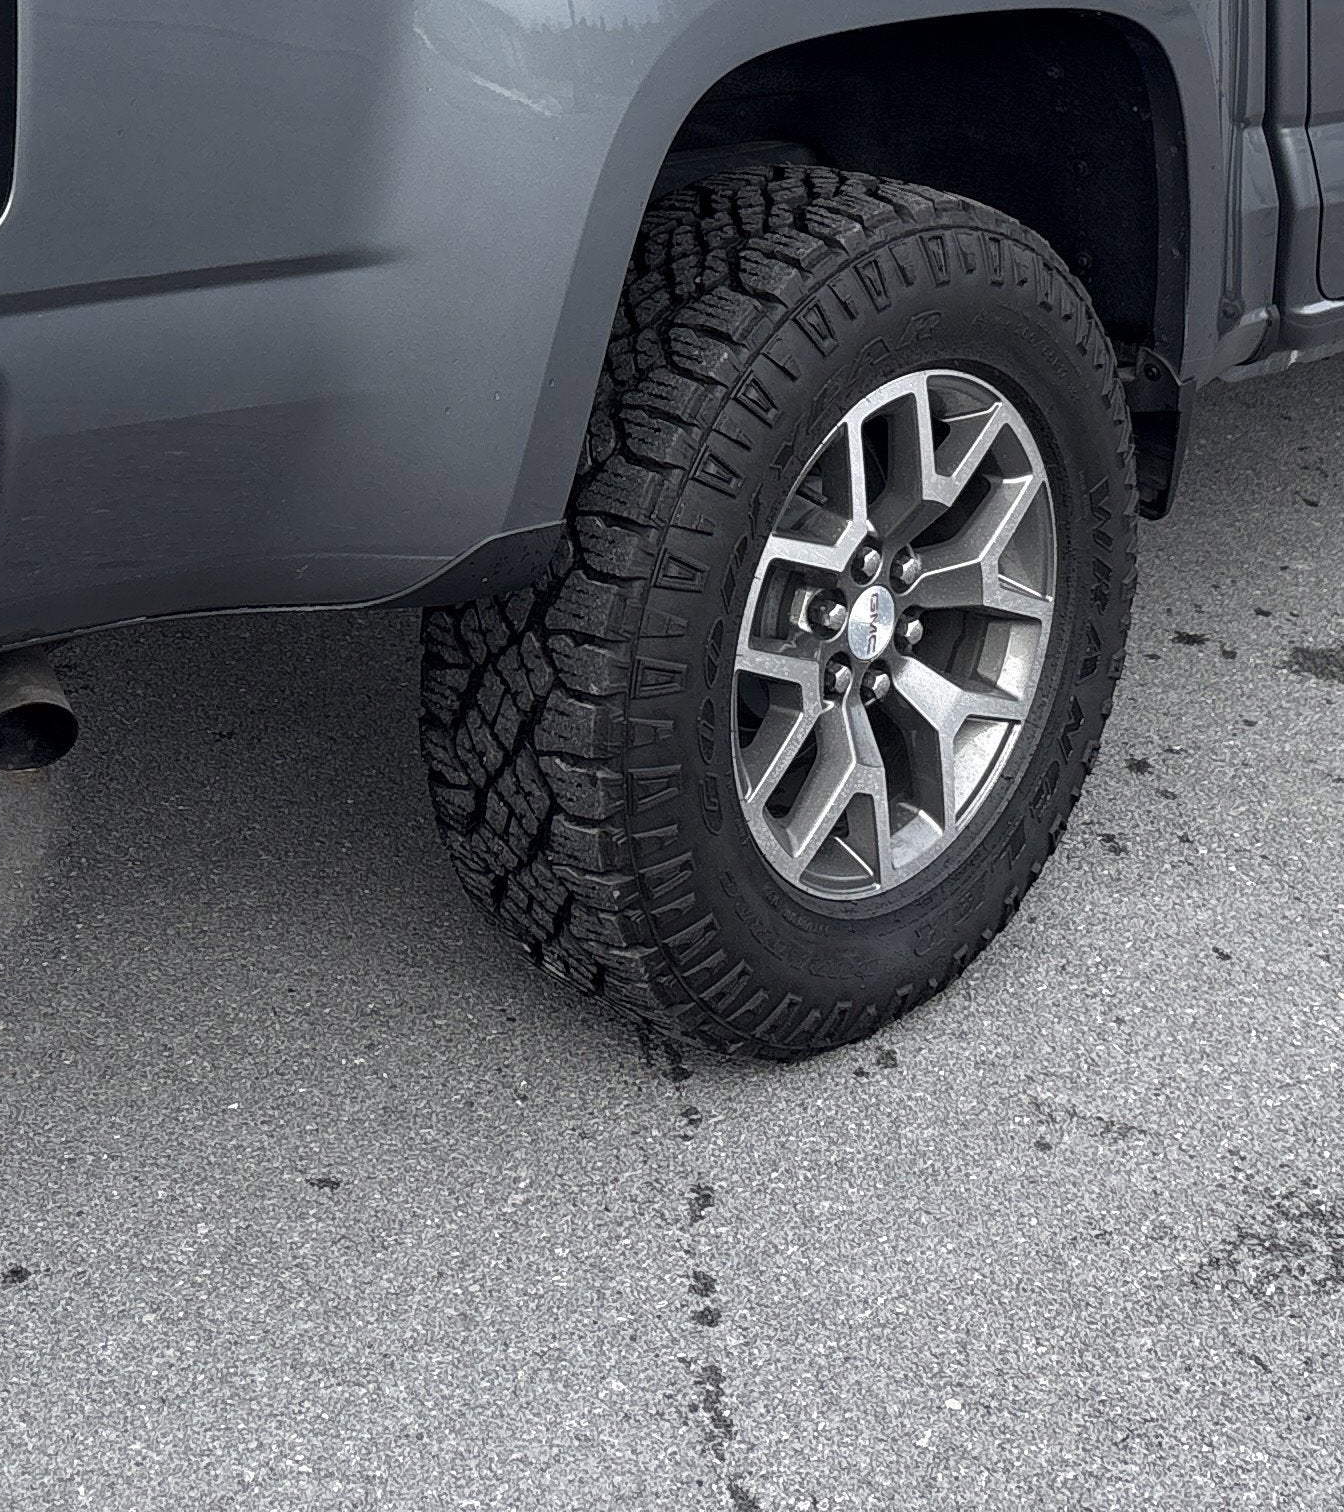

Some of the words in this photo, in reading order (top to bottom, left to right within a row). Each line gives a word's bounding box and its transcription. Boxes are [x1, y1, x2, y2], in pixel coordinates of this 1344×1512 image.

[698, 310, 943, 835] GOODYEAR
[866, 592, 879, 655] GMC
[914, 475, 1114, 956] WRANGLER
